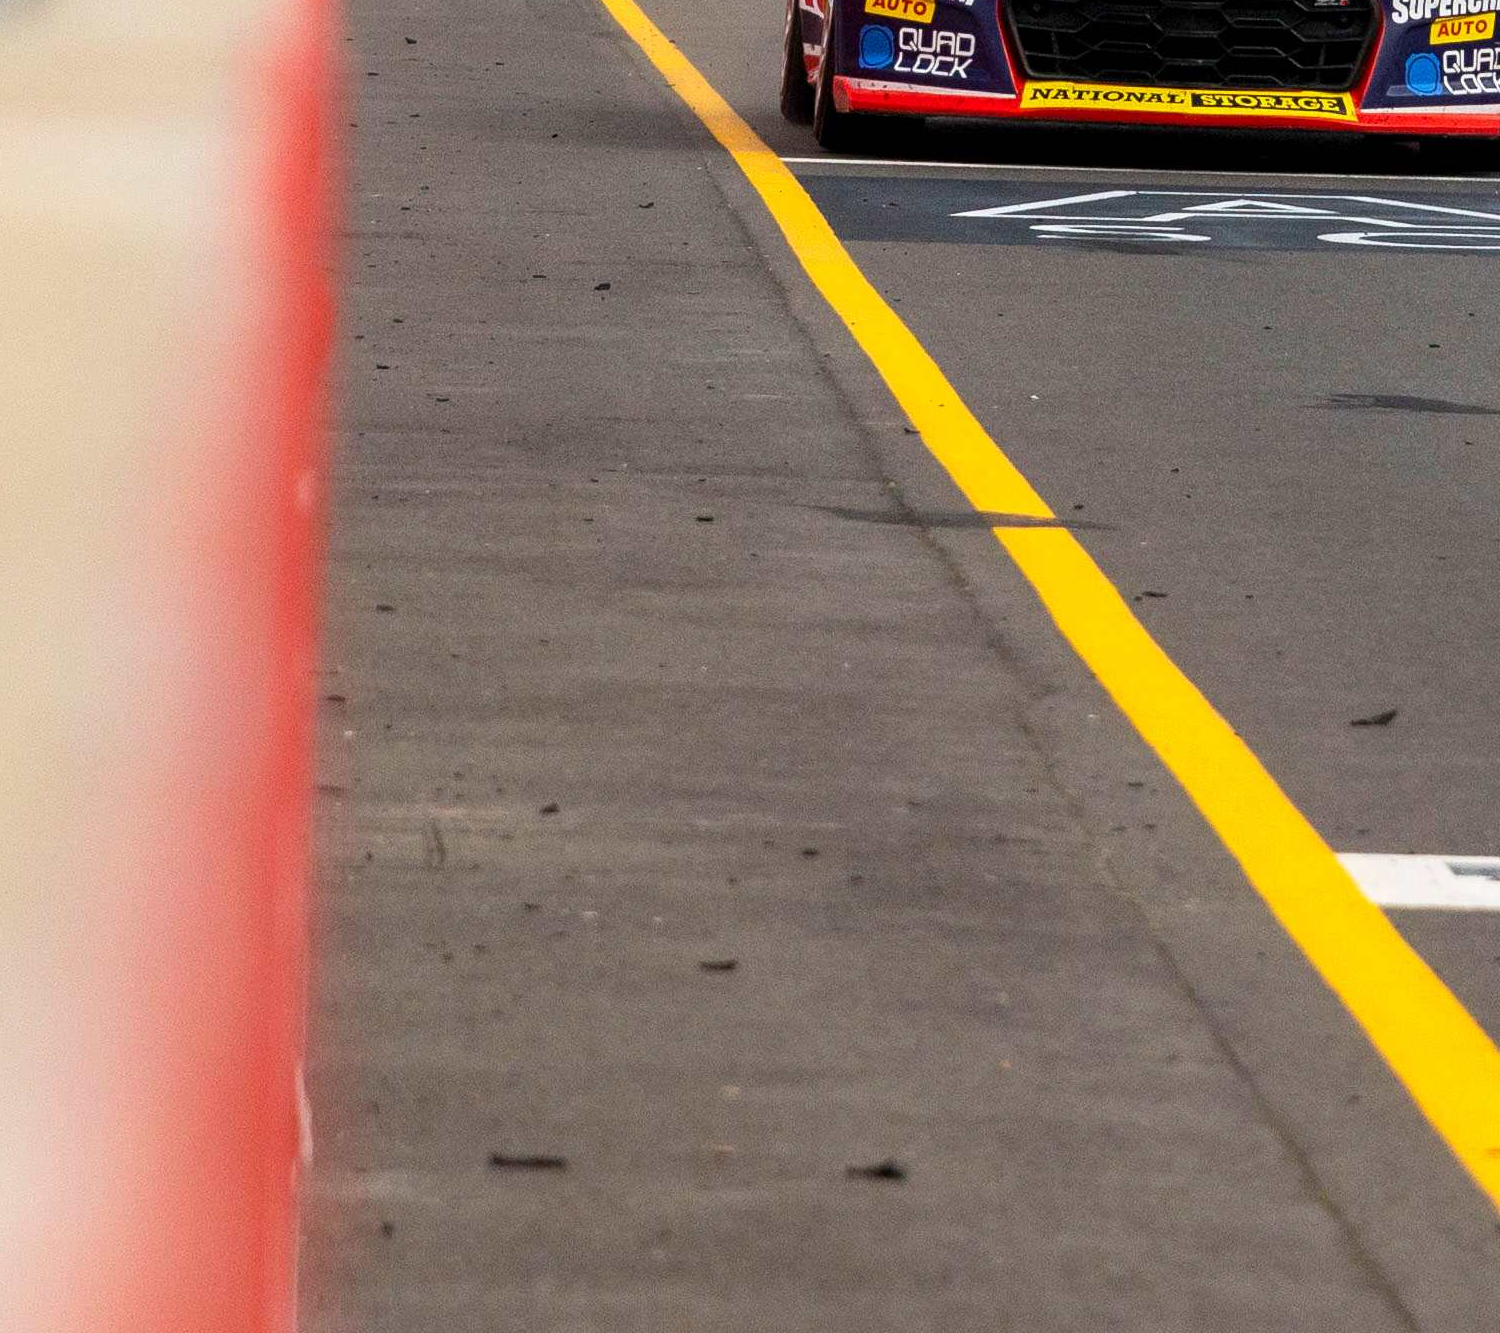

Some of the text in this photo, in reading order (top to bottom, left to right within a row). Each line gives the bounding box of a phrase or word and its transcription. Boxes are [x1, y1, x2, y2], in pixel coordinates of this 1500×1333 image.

[1437, 19, 1488, 38] AUTO
[899, 27, 975, 57] QUAD
[894, 55, 973, 79] LOCK
[1030, 87, 1340, 112] NATIONAL STORAGE
